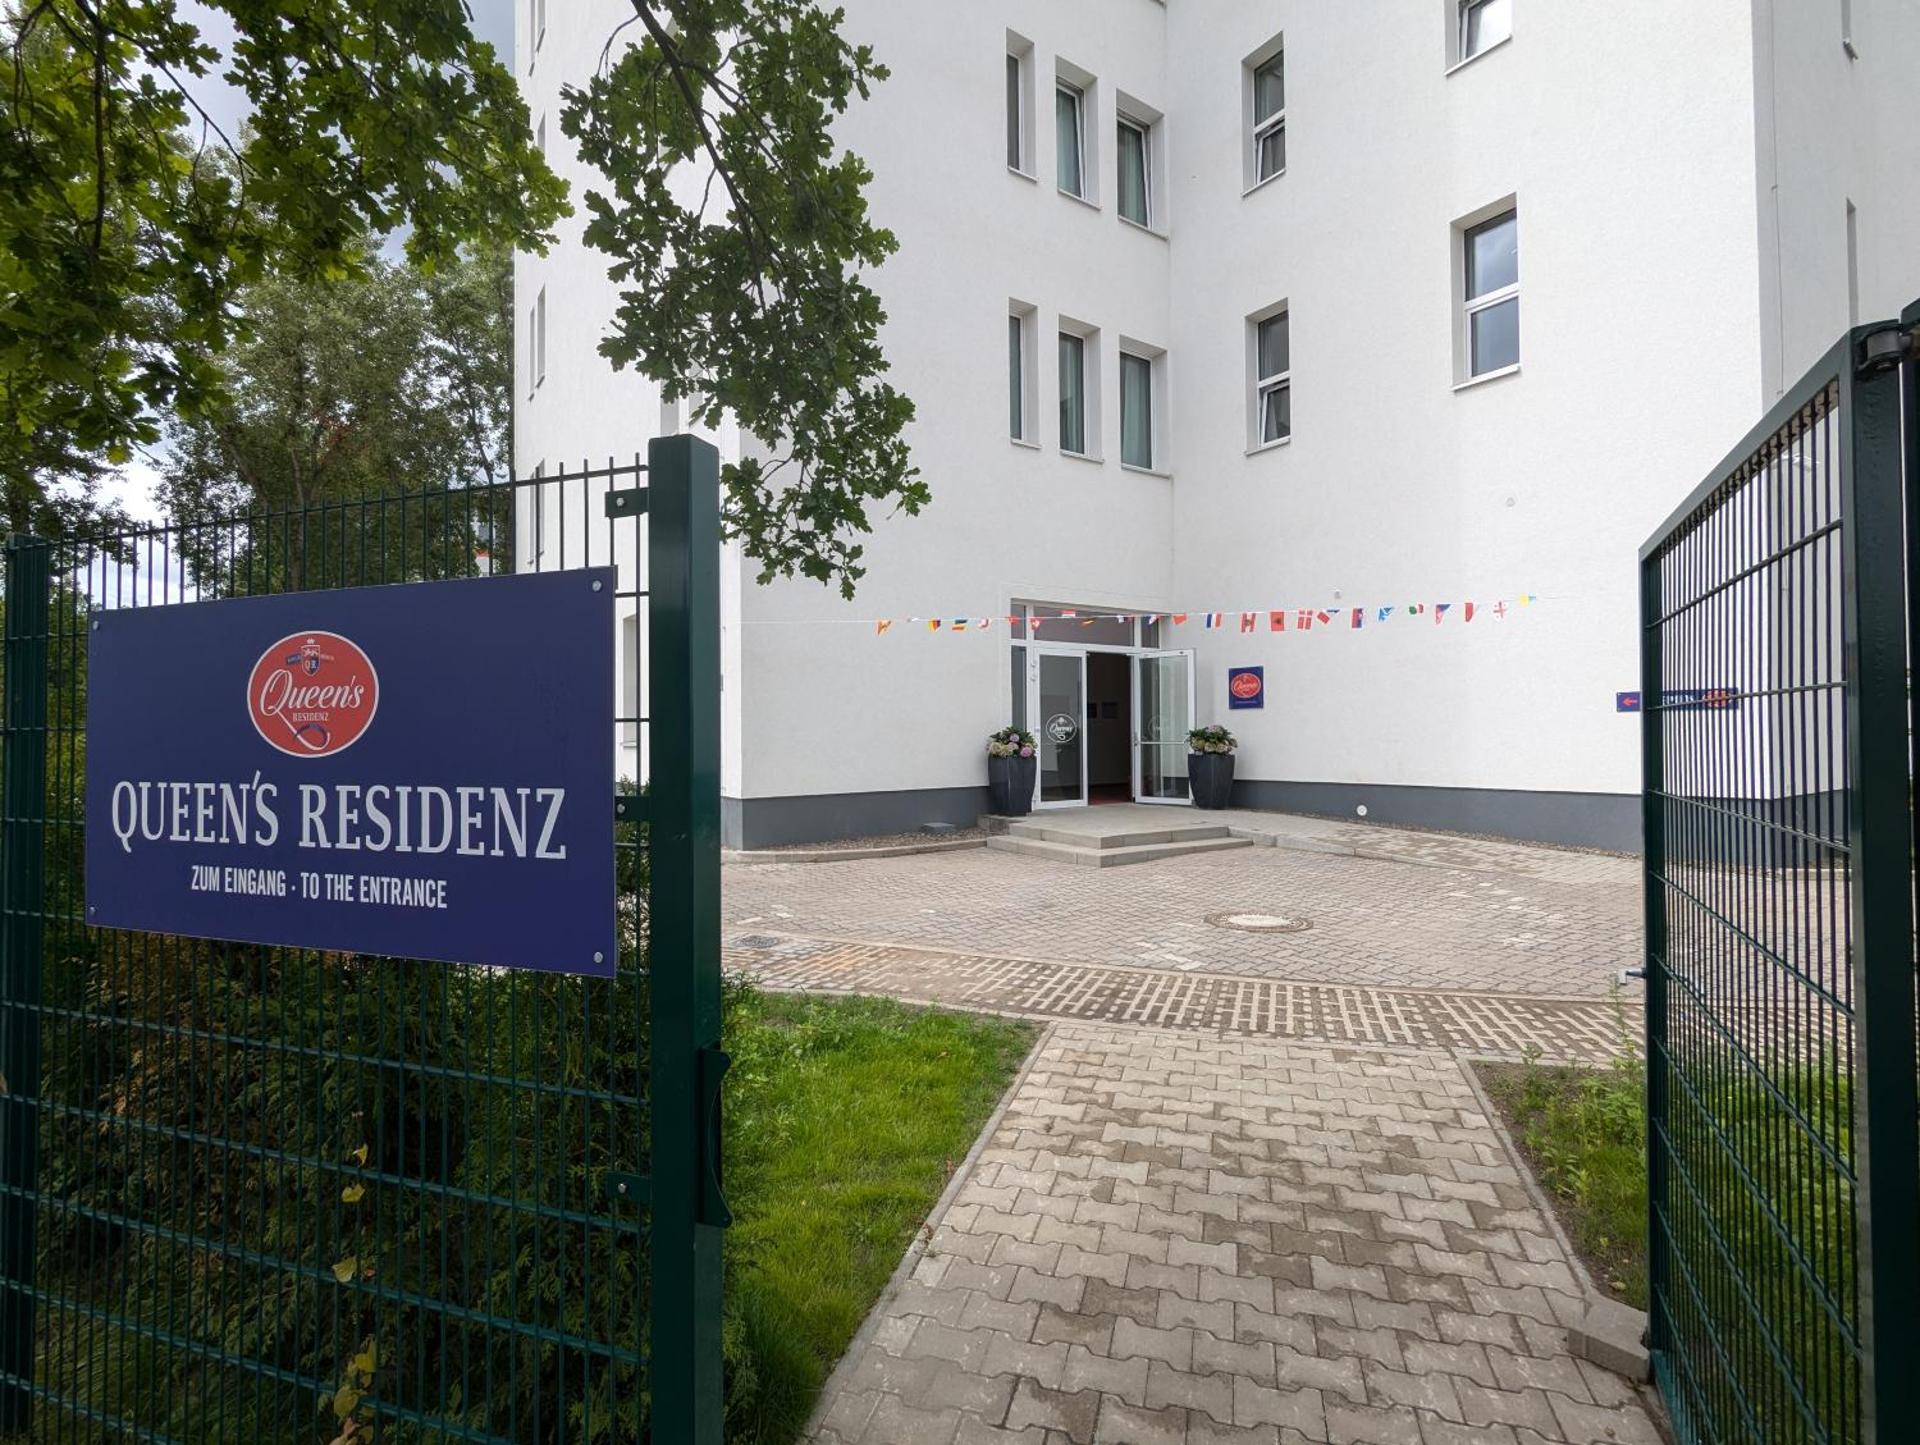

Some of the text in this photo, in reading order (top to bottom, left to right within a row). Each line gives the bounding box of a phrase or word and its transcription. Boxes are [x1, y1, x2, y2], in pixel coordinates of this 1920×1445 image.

[260, 669, 364, 750] Queen's
[292, 712, 329, 722] RESIDENZ
[112, 770, 566, 859] QUEEN'S RESIDENZ
[191, 865, 220, 891] ZUM
[224, 867, 287, 897] EINGANG
[300, 872, 320, 900] TO
[325, 874, 354, 902] THE
[360, 876, 448, 909] ENTRANCE
